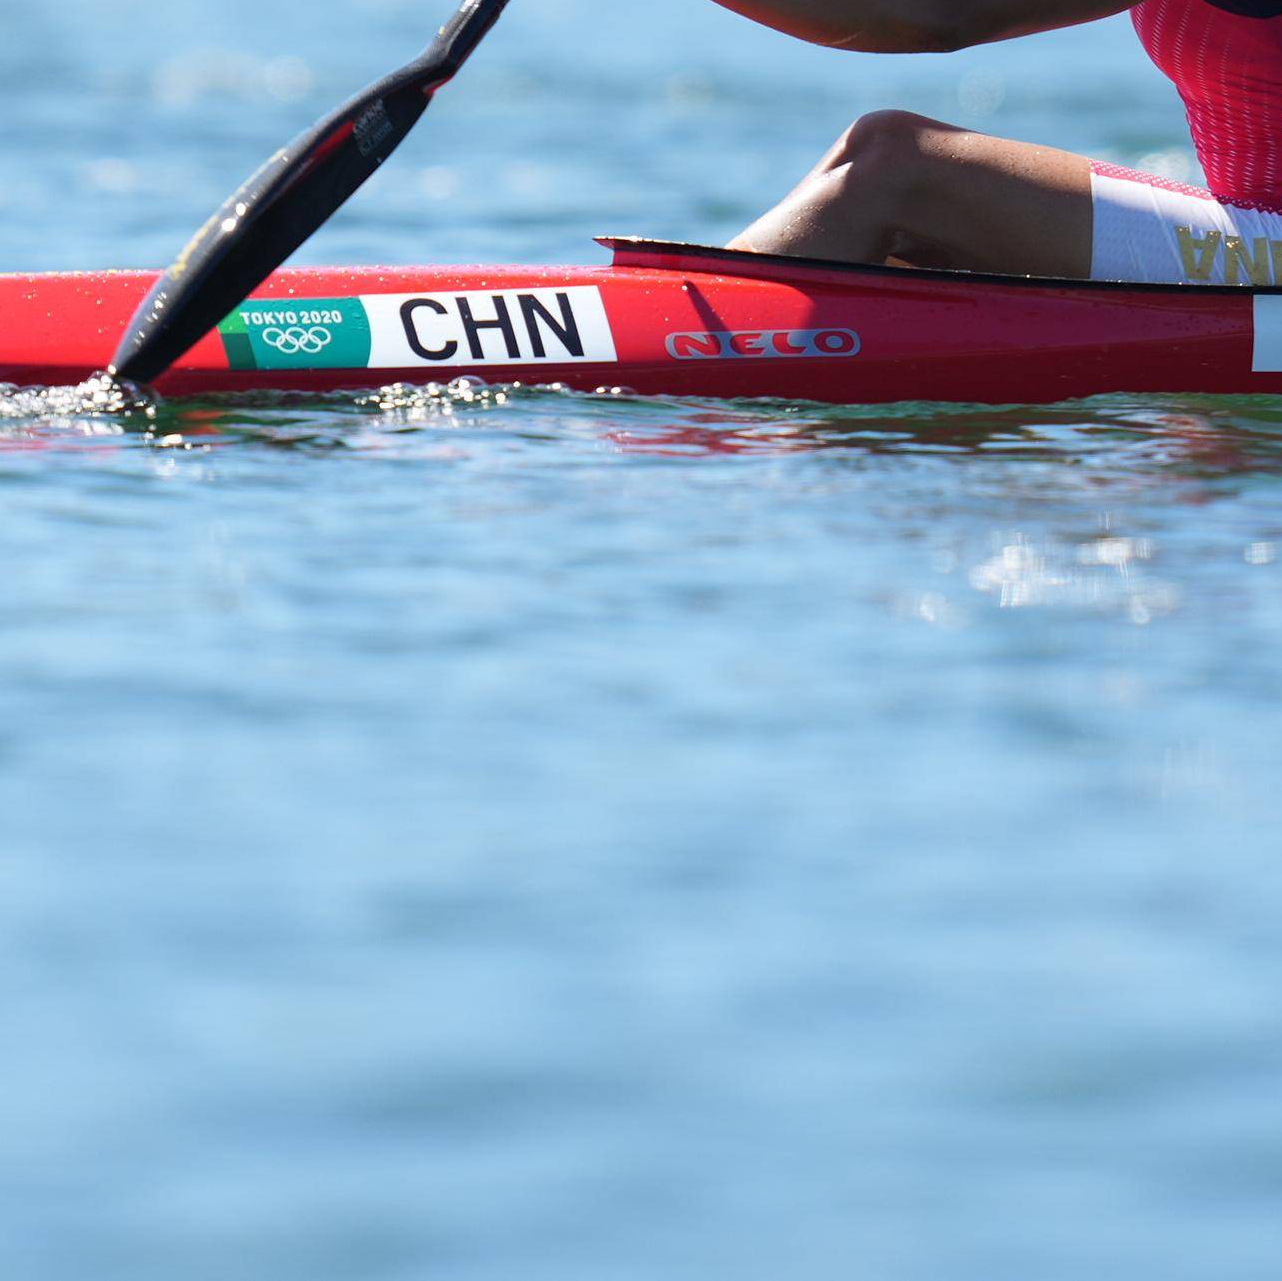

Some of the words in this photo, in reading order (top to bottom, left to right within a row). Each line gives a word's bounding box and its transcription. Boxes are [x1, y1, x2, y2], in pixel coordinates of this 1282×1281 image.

[239, 311, 298, 325] TOKYO
[299, 310, 343, 324] 2020
[399, 292, 585, 361] CHN
[673, 331, 855, 357] NELO
